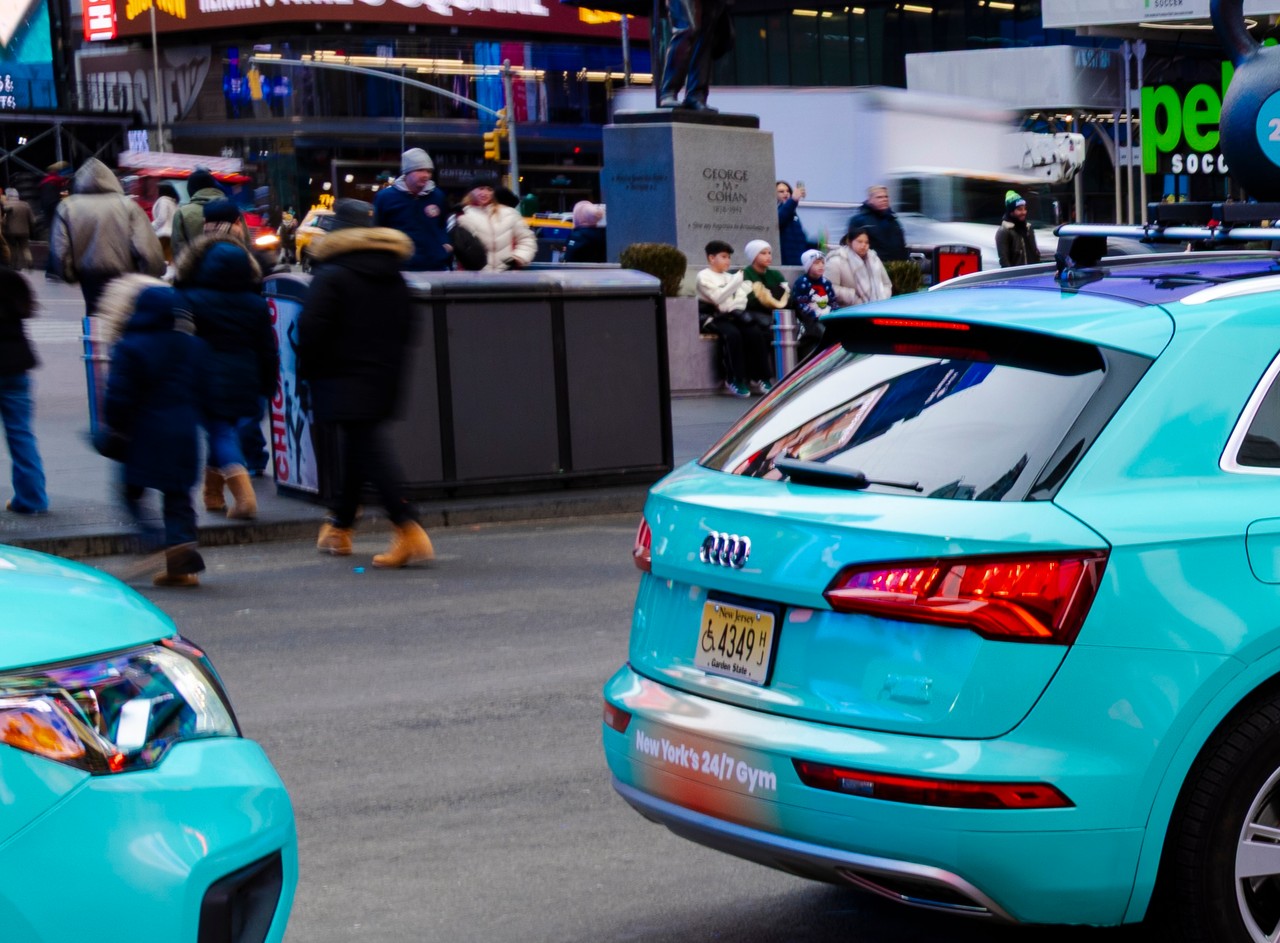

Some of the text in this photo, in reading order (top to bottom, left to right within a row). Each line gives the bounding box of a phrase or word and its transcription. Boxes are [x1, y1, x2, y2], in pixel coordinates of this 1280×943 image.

[702, 168, 749, 182] GEORGE
[722, 182, 733, 191] M
[706, 190, 748, 203] COHAN
[719, 606, 754, 625] New Jersey
[718, 622, 755, 662] 4349
[711, 658, 747, 676] Garden State
[636, 729, 777, 792] New York's 24/7 Gym
